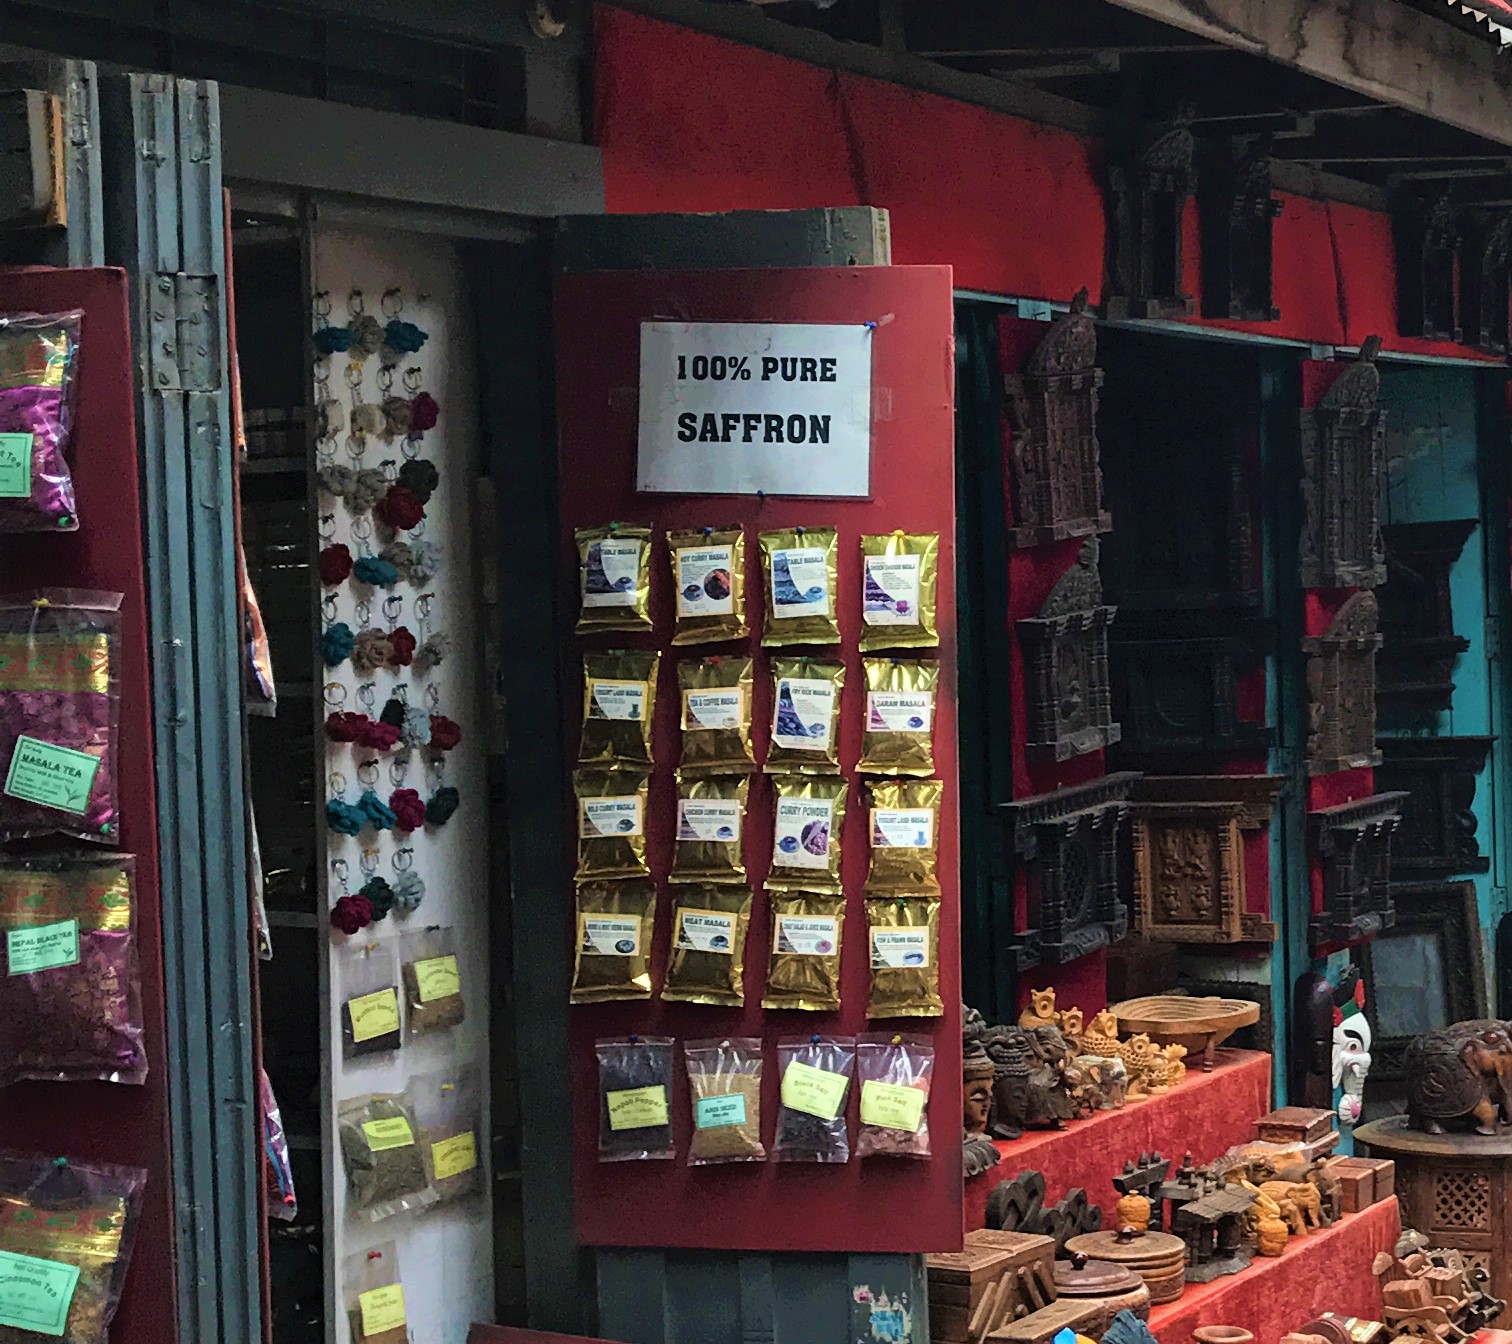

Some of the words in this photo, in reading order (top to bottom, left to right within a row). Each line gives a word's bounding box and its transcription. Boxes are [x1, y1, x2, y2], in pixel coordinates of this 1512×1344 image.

[678, 355, 751, 383] 100%
[761, 356, 837, 383] PURE
[677, 413, 832, 444] SAFFRON
[21, 753, 60, 772] MASALA
[63, 765, 82, 778] TEA
[780, 805, 801, 816] CURRY
[802, 806, 829, 817] POWDER
[11, 939, 35, 947] NEPAL
[44, 1282, 57, 1298] Tea
